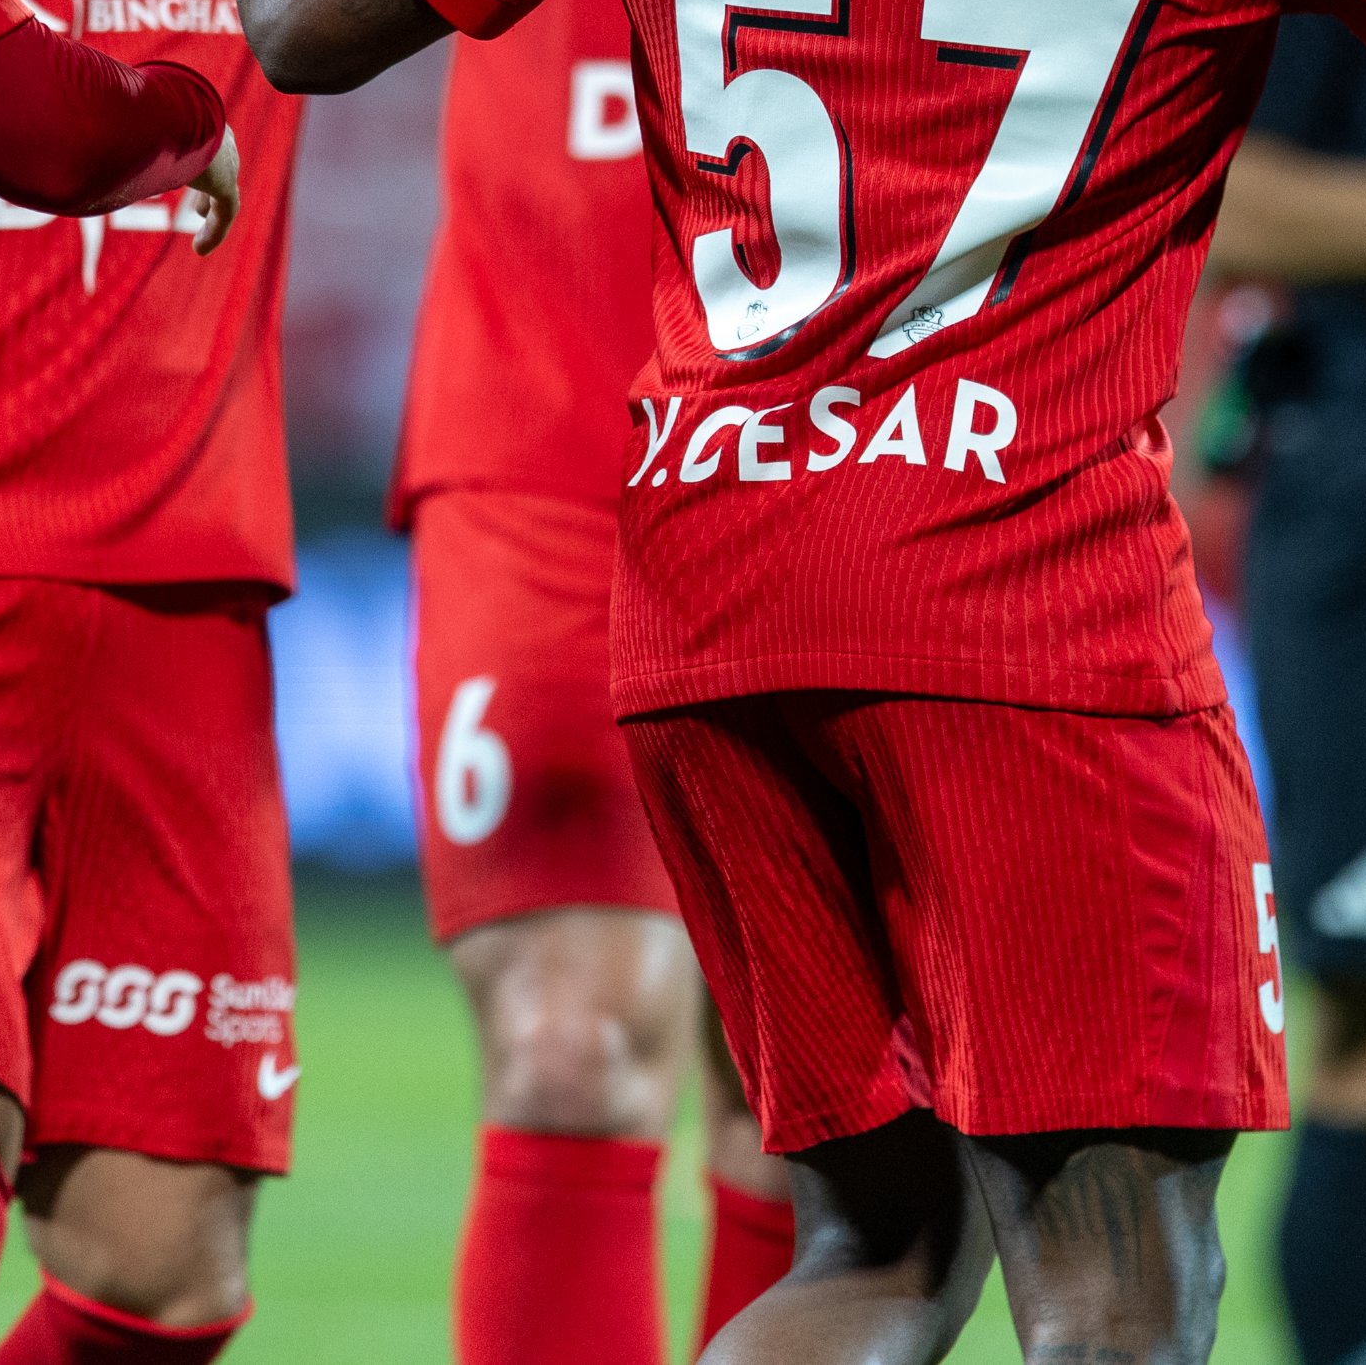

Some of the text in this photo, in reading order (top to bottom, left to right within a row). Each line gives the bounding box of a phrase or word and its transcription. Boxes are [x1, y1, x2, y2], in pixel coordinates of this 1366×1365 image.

[627, 378, 1019, 488] Y.CESAR
[436, 675, 511, 845] 6
[1251, 862, 1285, 1035] 5
